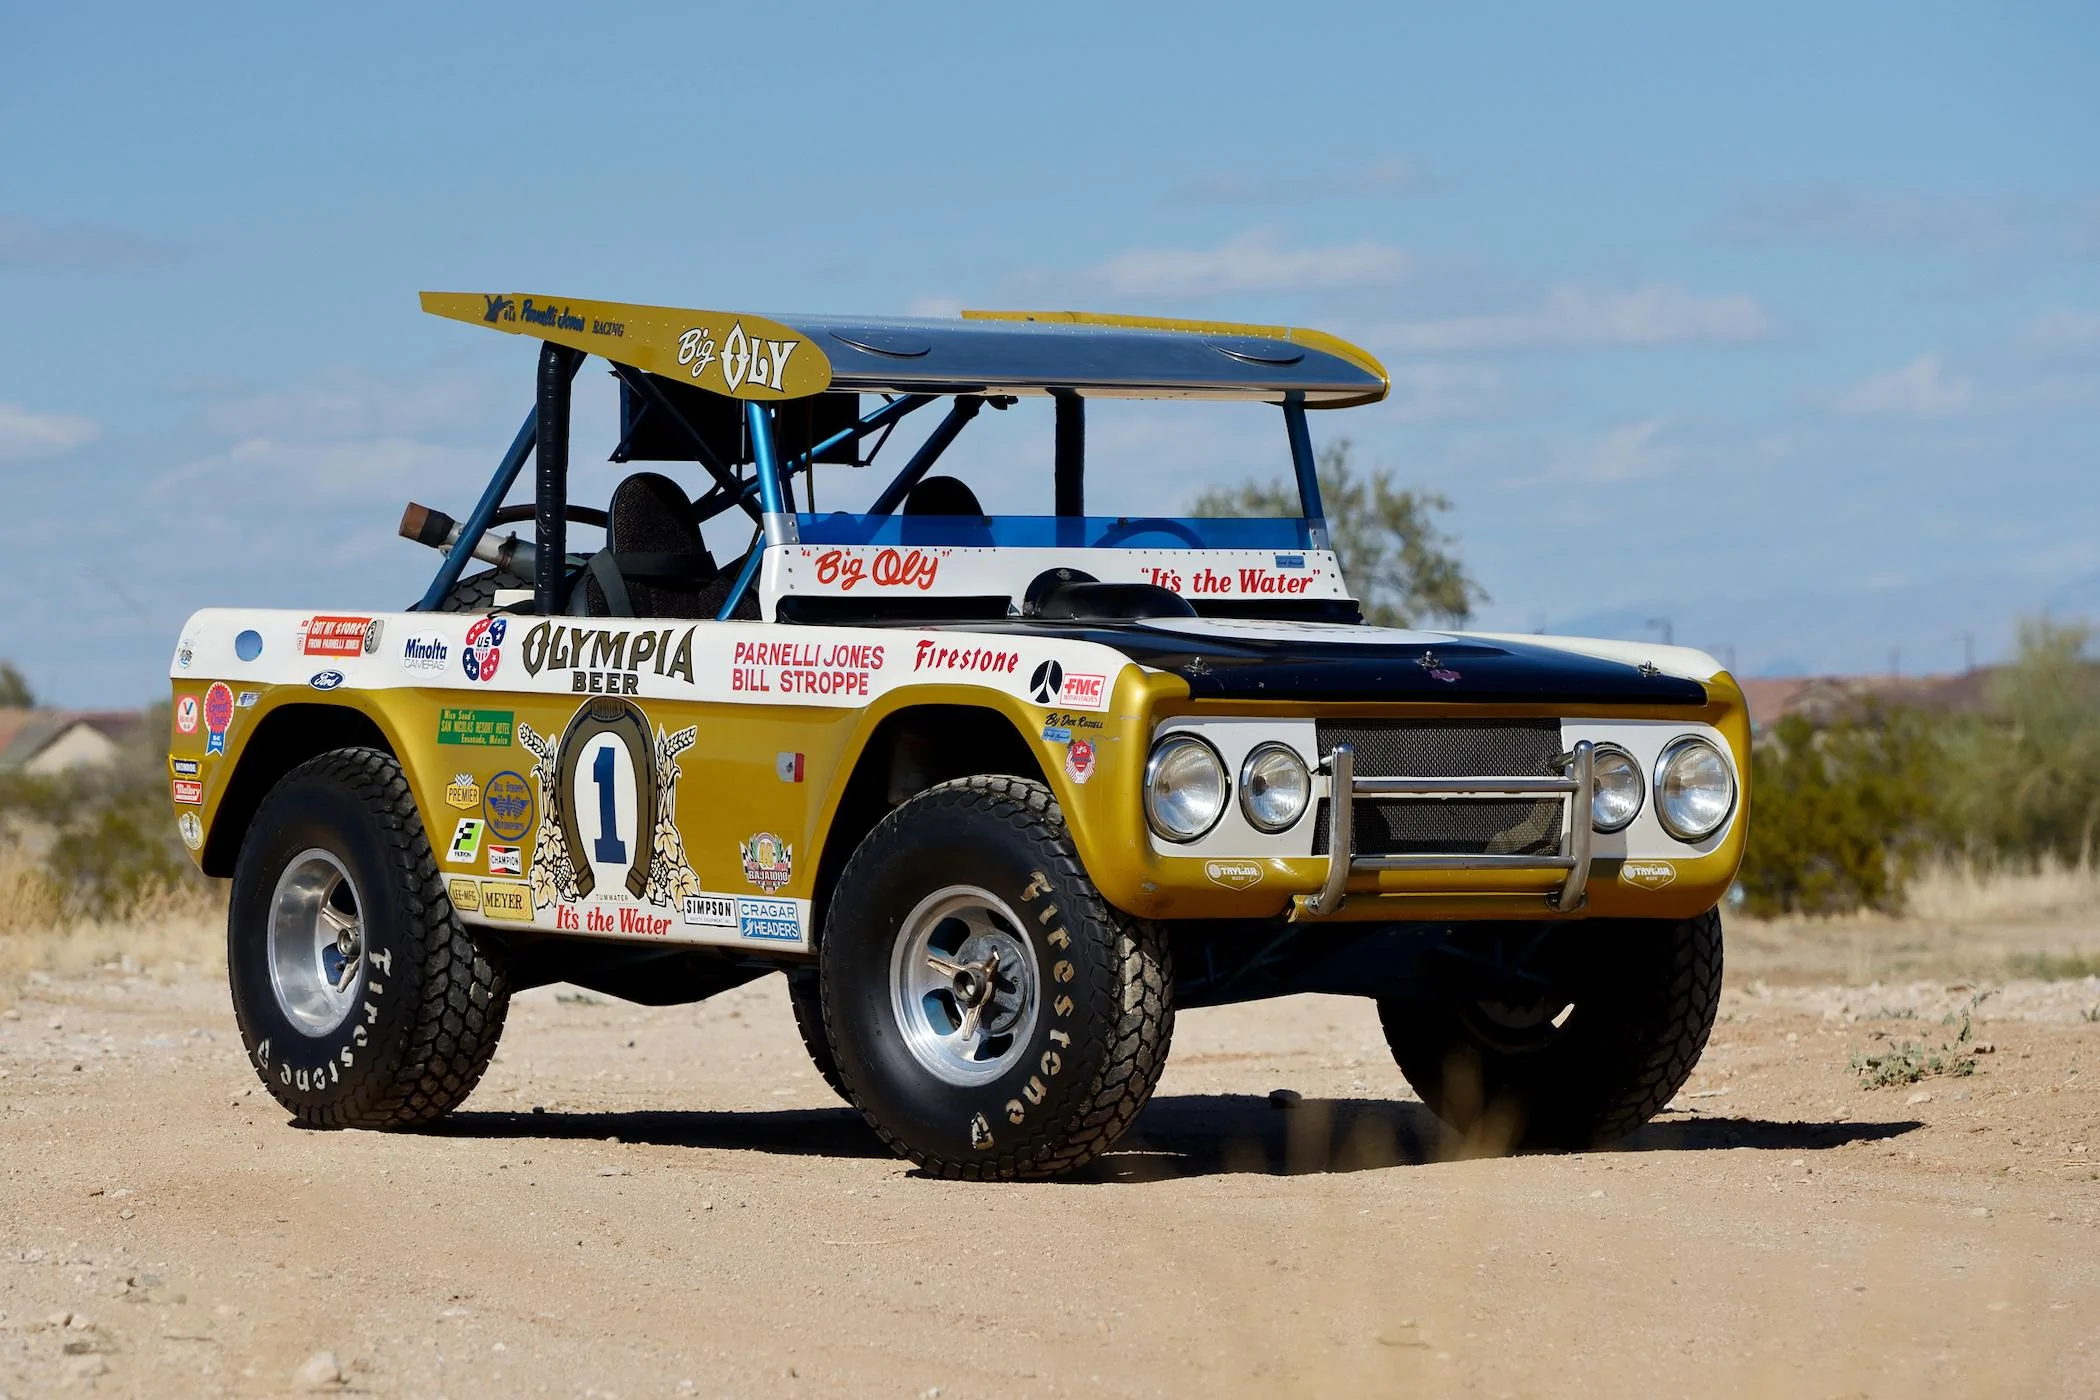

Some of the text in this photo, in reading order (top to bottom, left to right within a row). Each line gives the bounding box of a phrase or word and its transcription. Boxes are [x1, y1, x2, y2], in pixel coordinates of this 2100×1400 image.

[592, 318, 625, 338] RACING
[678, 319, 800, 395] Big OLY
[1193, 568, 1232, 593] the
[404, 638, 448, 660] Minolta
[522, 619, 700, 686] OLYMPIA
[734, 642, 885, 670] PARNELLI JONES
[913, 639, 1019, 674] Firestone
[403, 658, 445, 671] CAMERAS
[313, 672, 339, 687] Ford
[572, 671, 640, 695] BEER
[732, 668, 869, 696] BILL STROPPE
[1065, 678, 1101, 696] FMC
[441, 720, 452, 732] SAN
[1045, 712, 1061, 727] By
[448, 787, 478, 803] PREMIER
[593, 746, 627, 865] 1
[491, 855, 519, 866] CHAMPION
[1220, 866, 1258, 876] TAYLOR
[1635, 866, 1671, 876] TAYLOR
[485, 892, 522, 910] MEYER
[596, 893, 629, 901] TUMWATER
[687, 899, 731, 917] SIMPSON
[741, 903, 795, 919] CRAGAR
[556, 904, 672, 935] It's the Water
[754, 919, 798, 938] HEADERS
